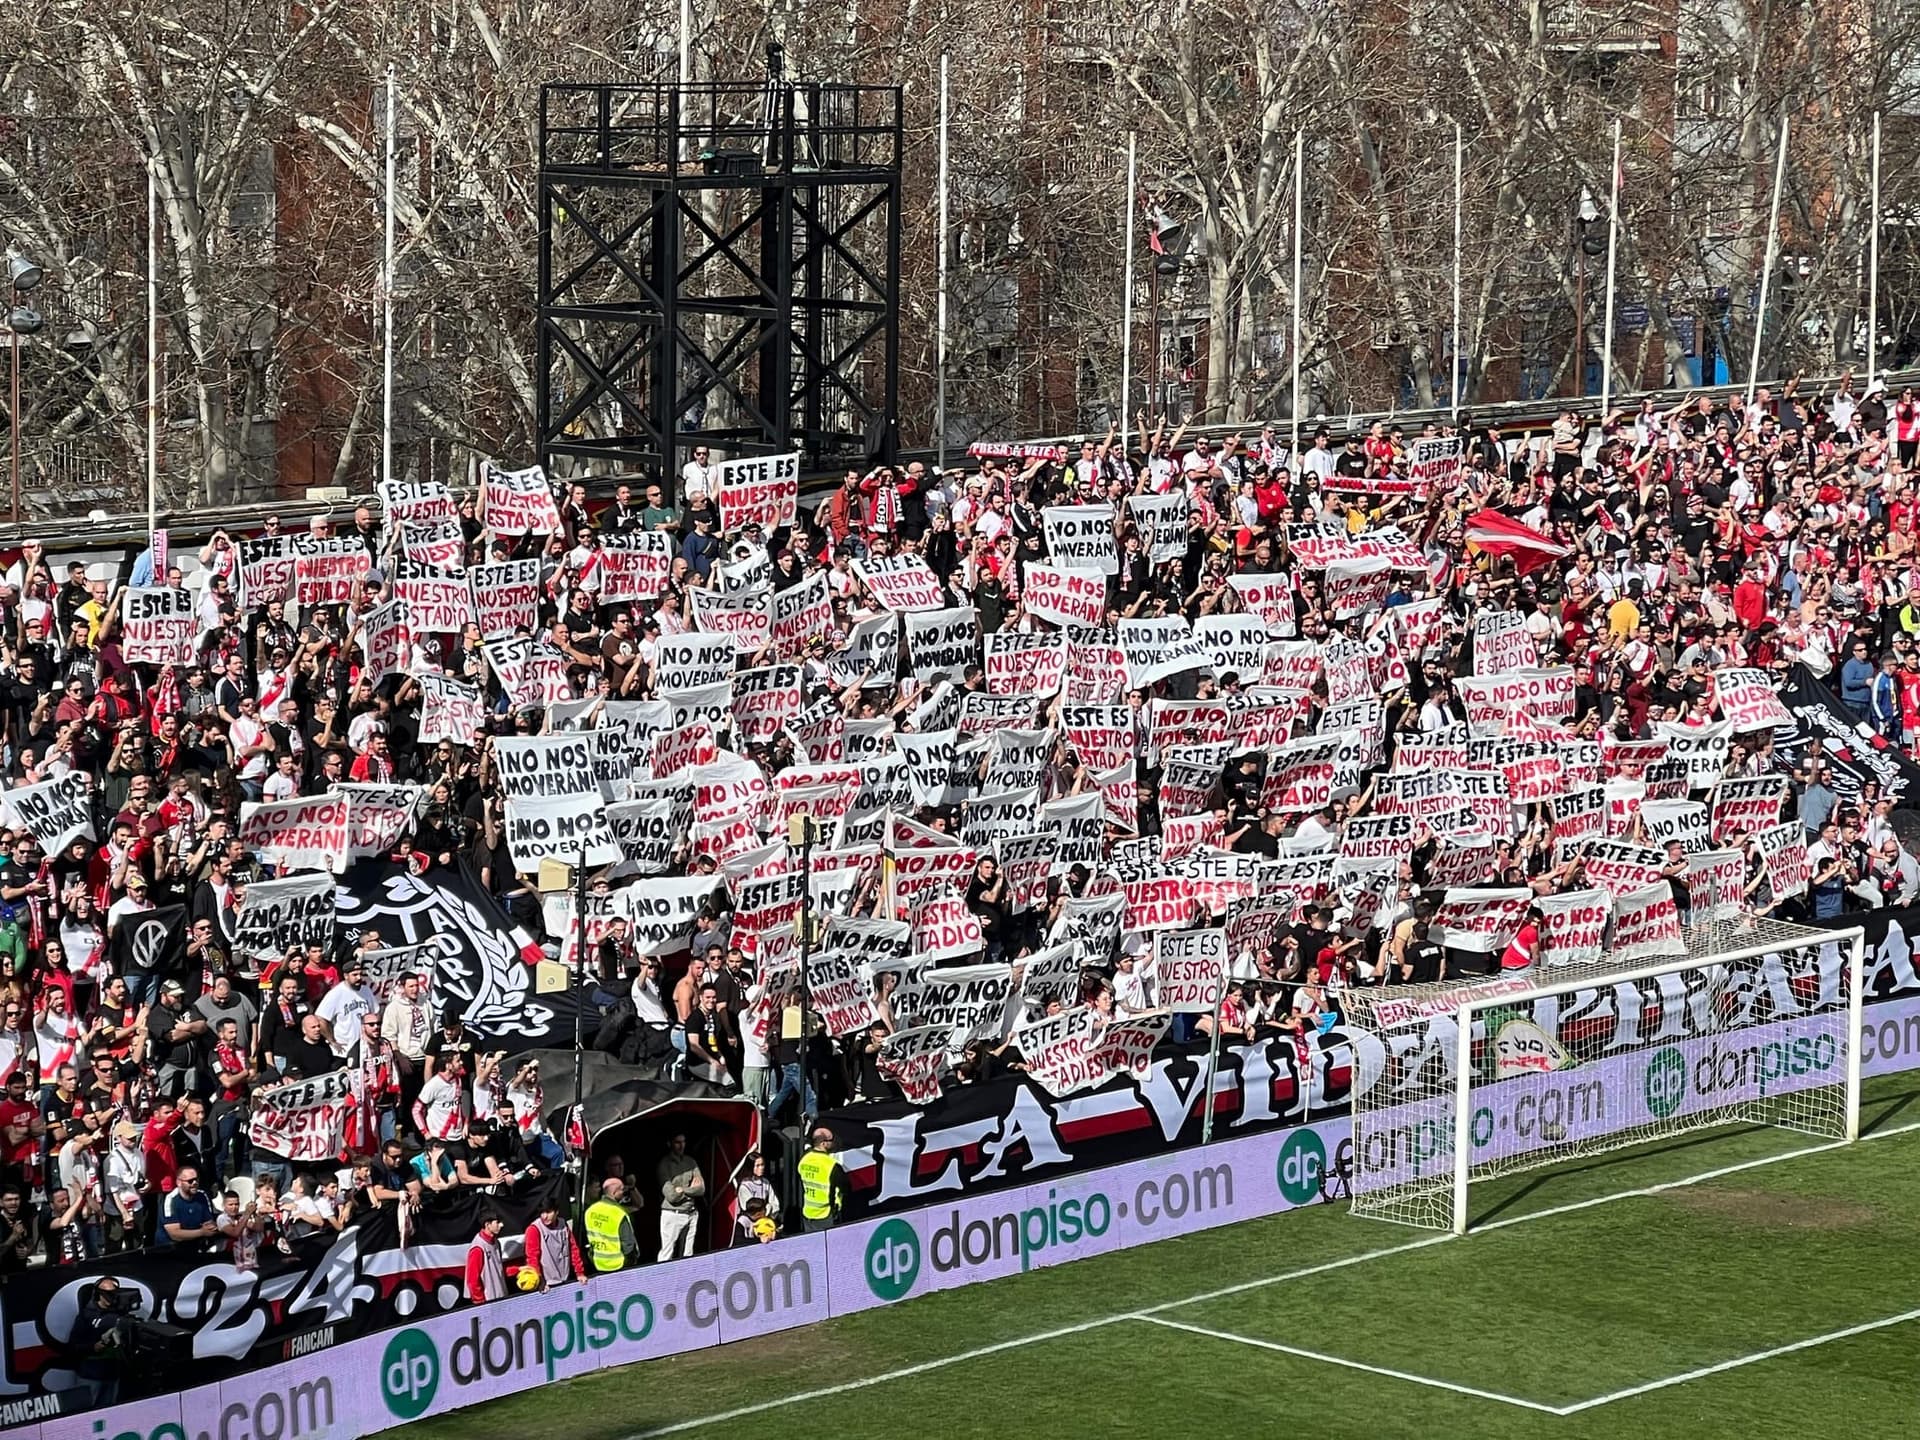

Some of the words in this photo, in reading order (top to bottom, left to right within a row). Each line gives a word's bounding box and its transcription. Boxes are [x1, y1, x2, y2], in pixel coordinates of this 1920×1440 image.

[522, 467, 543, 489] ES
[724, 463, 768, 486] ESTE
[776, 458, 794, 477] ES
[1411, 460, 1460, 478] NUESTRO
[388, 482, 430, 500] ESTE
[486, 488, 552, 510] NUESTRO
[721, 481, 796, 507] NUESTRO
[1160, 504, 1187, 521] NOS
[406, 526, 436, 544] ESTE
[1081, 519, 1111, 535] NOS
[241, 538, 289, 565] ESTE
[606, 533, 640, 549] ESTE
[650, 533, 664, 550] ES
[297, 557, 369, 578] NUESTRO
[475, 565, 513, 586] ESTE
[520, 560, 537, 580] ES
[601, 554, 668, 572] NUESTRO
[864, 555, 901, 574] ESTE
[604, 574, 669, 595] ESTADIO
[868, 569, 938, 591] NUESTRO
[1068, 576, 1104, 596] NOS
[1358, 571, 1390, 587] NOS
[394, 583, 468, 602] NUESTRO
[477, 586, 537, 608] NUESTRO
[697, 592, 736, 610] ESTE
[742, 591, 770, 610] ES
[777, 593, 805, 619] ESTE
[809, 582, 824, 600] ES
[886, 586, 943, 608] ESTADIO
[1260, 584, 1290, 600] NOS
[130, 594, 170, 619] ESTE
[176, 589, 191, 612] ES
[1025, 590, 1103, 627] MOVERÁN!
[482, 610, 534, 632] ESTADIO
[700, 614, 768, 632] NUESTRO
[774, 603, 831, 640] NUESTRO
[944, 622, 975, 641] NOS
[1477, 613, 1506, 635] ESTE
[1510, 611, 1522, 628] ES
[992, 633, 1034, 649] ESTE
[1040, 632, 1062, 646] ES
[1121, 627, 1151, 642] ¡NO
[1157, 626, 1192, 642] NOS
[1475, 629, 1530, 653] NUESTRO
[492, 639, 540, 665] ESTE
[699, 646, 734, 665] NOS
[987, 650, 1063, 673] NUESTRO
[1066, 644, 1124, 665] NUESTRO
[1477, 650, 1534, 674] ESTADIO
[775, 667, 799, 687] ES
[1264, 657, 1283, 675] NO
[989, 673, 1057, 694] ESTADIO
[1493, 680, 1527, 703] NOS
[1545, 676, 1573, 697] NOS
[1718, 671, 1754, 691] ESTE
[966, 696, 1006, 715] ESTE
[1013, 696, 1033, 714] ES
[1063, 707, 1103, 726] ESTE
[1112, 708, 1128, 726] ES
[1153, 707, 1187, 726] ¡NO
[1323, 704, 1364, 728] ESTE
[1067, 730, 1133, 748] NUESTRO
[1403, 730, 1446, 745] ESTE
[1450, 727, 1466, 744] ES
[550, 743, 587, 768] NOS
[992, 749, 1020, 764] ¡NO
[1272, 749, 1309, 772] ESTE
[1316, 744, 1339, 760] ES
[1399, 748, 1469, 768] NUESTRO
[1495, 742, 1534, 764] ESTE
[1580, 745, 1599, 761] ES
[506, 768, 597, 796] MOVERÁN!
[1264, 764, 1334, 791] NUESTRO
[1402, 777, 1432, 799] ESTE
[1436, 772, 1453, 791] ES
[48, 773, 87, 805] NOS
[387, 790, 414, 807] ES
[1721, 782, 1754, 800] ESTE
[1759, 778, 1781, 796] ES
[813, 797, 850, 817] NOS
[997, 803, 1037, 820] NOS
[1556, 796, 1584, 819] ESTE
[1588, 788, 1604, 809] ES
[243, 809, 288, 833] ¡NO
[295, 801, 348, 827] NOS
[509, 818, 550, 842] ¡NO
[558, 807, 608, 836] NOS
[1349, 820, 1384, 840] ESTE
[1388, 815, 1410, 834] ES
[1459, 807, 1478, 827] ES
[1649, 818, 1676, 841] ¡NO
[1677, 810, 1708, 833] NOS
[844, 820, 885, 844] NOS
[1067, 818, 1104, 839] NOS
[1165, 823, 1196, 843] ¡NO
[240, 825, 344, 855] MOVERÁN!
[513, 831, 614, 859] MOVERÁN!
[695, 835, 723, 856] NO
[1036, 838, 1058, 856] ES
[1343, 839, 1414, 858] NUESTRO
[1761, 829, 1788, 851] ESTE
[929, 851, 977, 872] NOS
[1236, 858, 1255, 877] ES
[1436, 847, 1495, 867] NUESTRO
[1636, 848, 1664, 865] ES
[1766, 845, 1808, 870] NUESTRO
[1713, 860, 1743, 879] NOS
[1773, 868, 1809, 894] ESTADIO
[741, 881, 780, 911] ESTE
[241, 905, 281, 928] ¡NO
[288, 889, 336, 921] NOS
[1439, 902, 1480, 917] ¡NO
[1483, 899, 1533, 914] NOS
[1571, 905, 1606, 924] NOS
[1645, 899, 1676, 920] NOS
[827, 929, 861, 948] ¡NO
[863, 934, 909, 956] NOS
[1160, 935, 1194, 957] ESTE
[1200, 934, 1220, 955] ES
[361, 953, 410, 977] ESTE
[414, 944, 436, 968] ES
[808, 960, 834, 986] ESTE
[834, 954, 850, 979] ES
[1158, 959, 1221, 981] NUESTRO
[813, 978, 863, 1010] NUESTRO
[920, 984, 960, 1006] ¡NO
[965, 977, 1010, 1002] NOS
[921, 1031, 950, 1050] ES
[1019, 1020, 1060, 1051] ESTE
[1067, 1010, 1088, 1033] ES
[323, 1073, 348, 1099] ES
[866, 1084, 1074, 1206] LA
[1282, 1145, 1319, 1189] dp
[871, 1237, 914, 1285] dp
[283, 1325, 335, 1359] #FANCAM
[386, 1352, 434, 1400] dp
